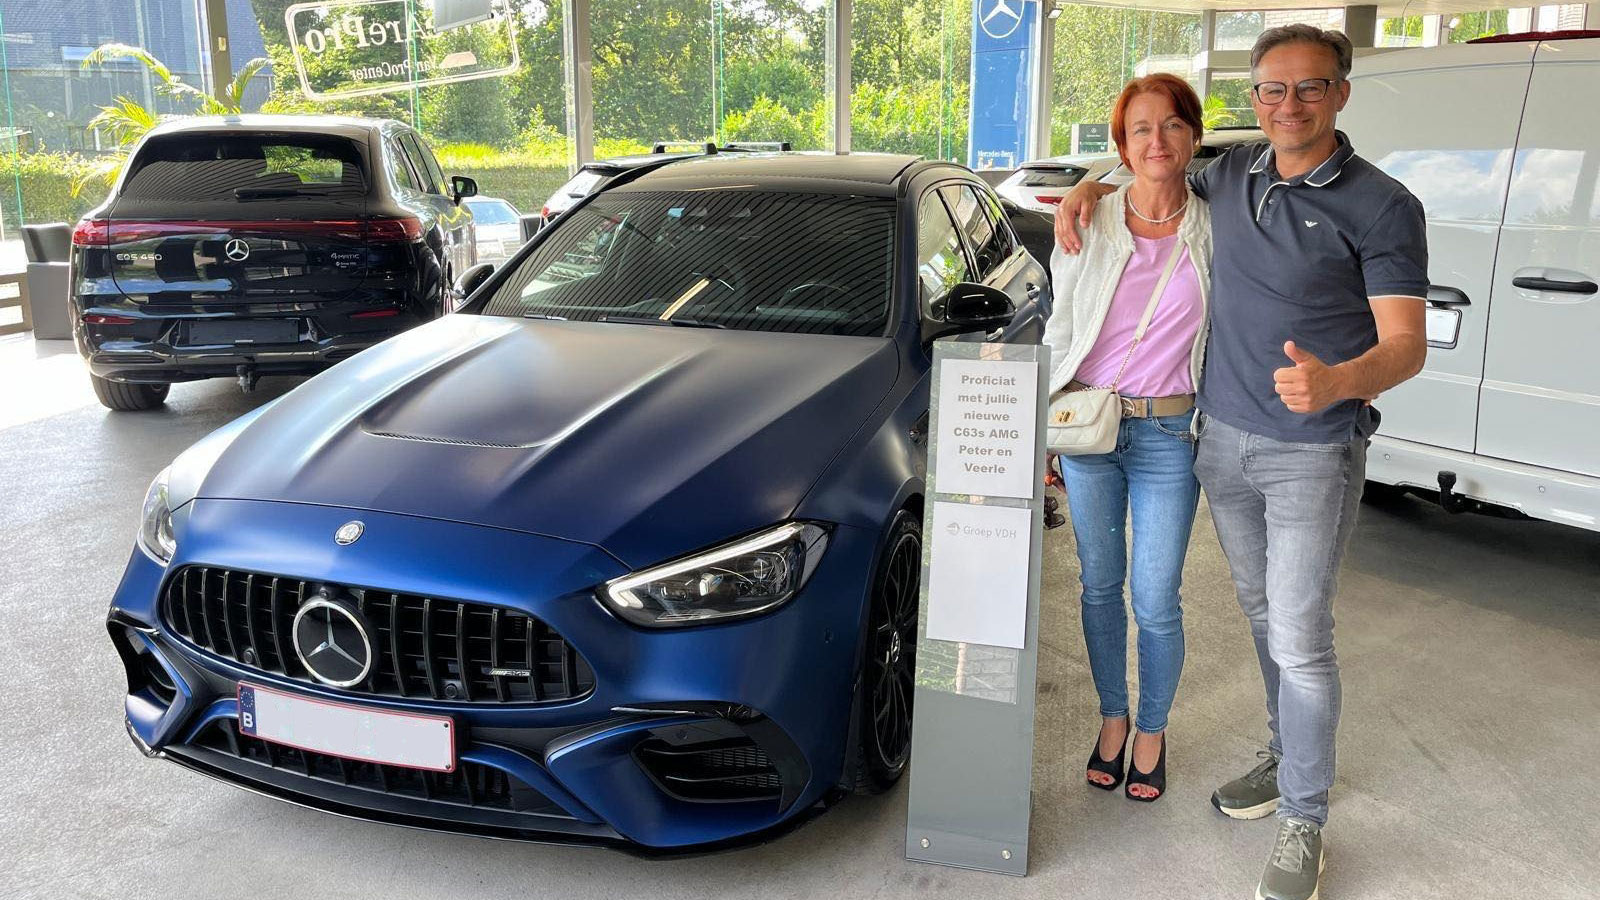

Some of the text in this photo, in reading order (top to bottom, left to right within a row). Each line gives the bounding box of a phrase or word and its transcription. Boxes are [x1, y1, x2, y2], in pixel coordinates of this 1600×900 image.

[116, 253, 163, 261] EQS 450
[961, 374, 1016, 386] Proficiat
[957, 394, 1018, 405] met jullie
[963, 411, 1010, 421] nieuwe
[953, 427, 1019, 439] C63s AMG
[958, 445, 1013, 457] Peter en
[964, 463, 1006, 474] Veerle
[963, 525, 1017, 539] Groep VDH
[242, 711, 254, 728] B
